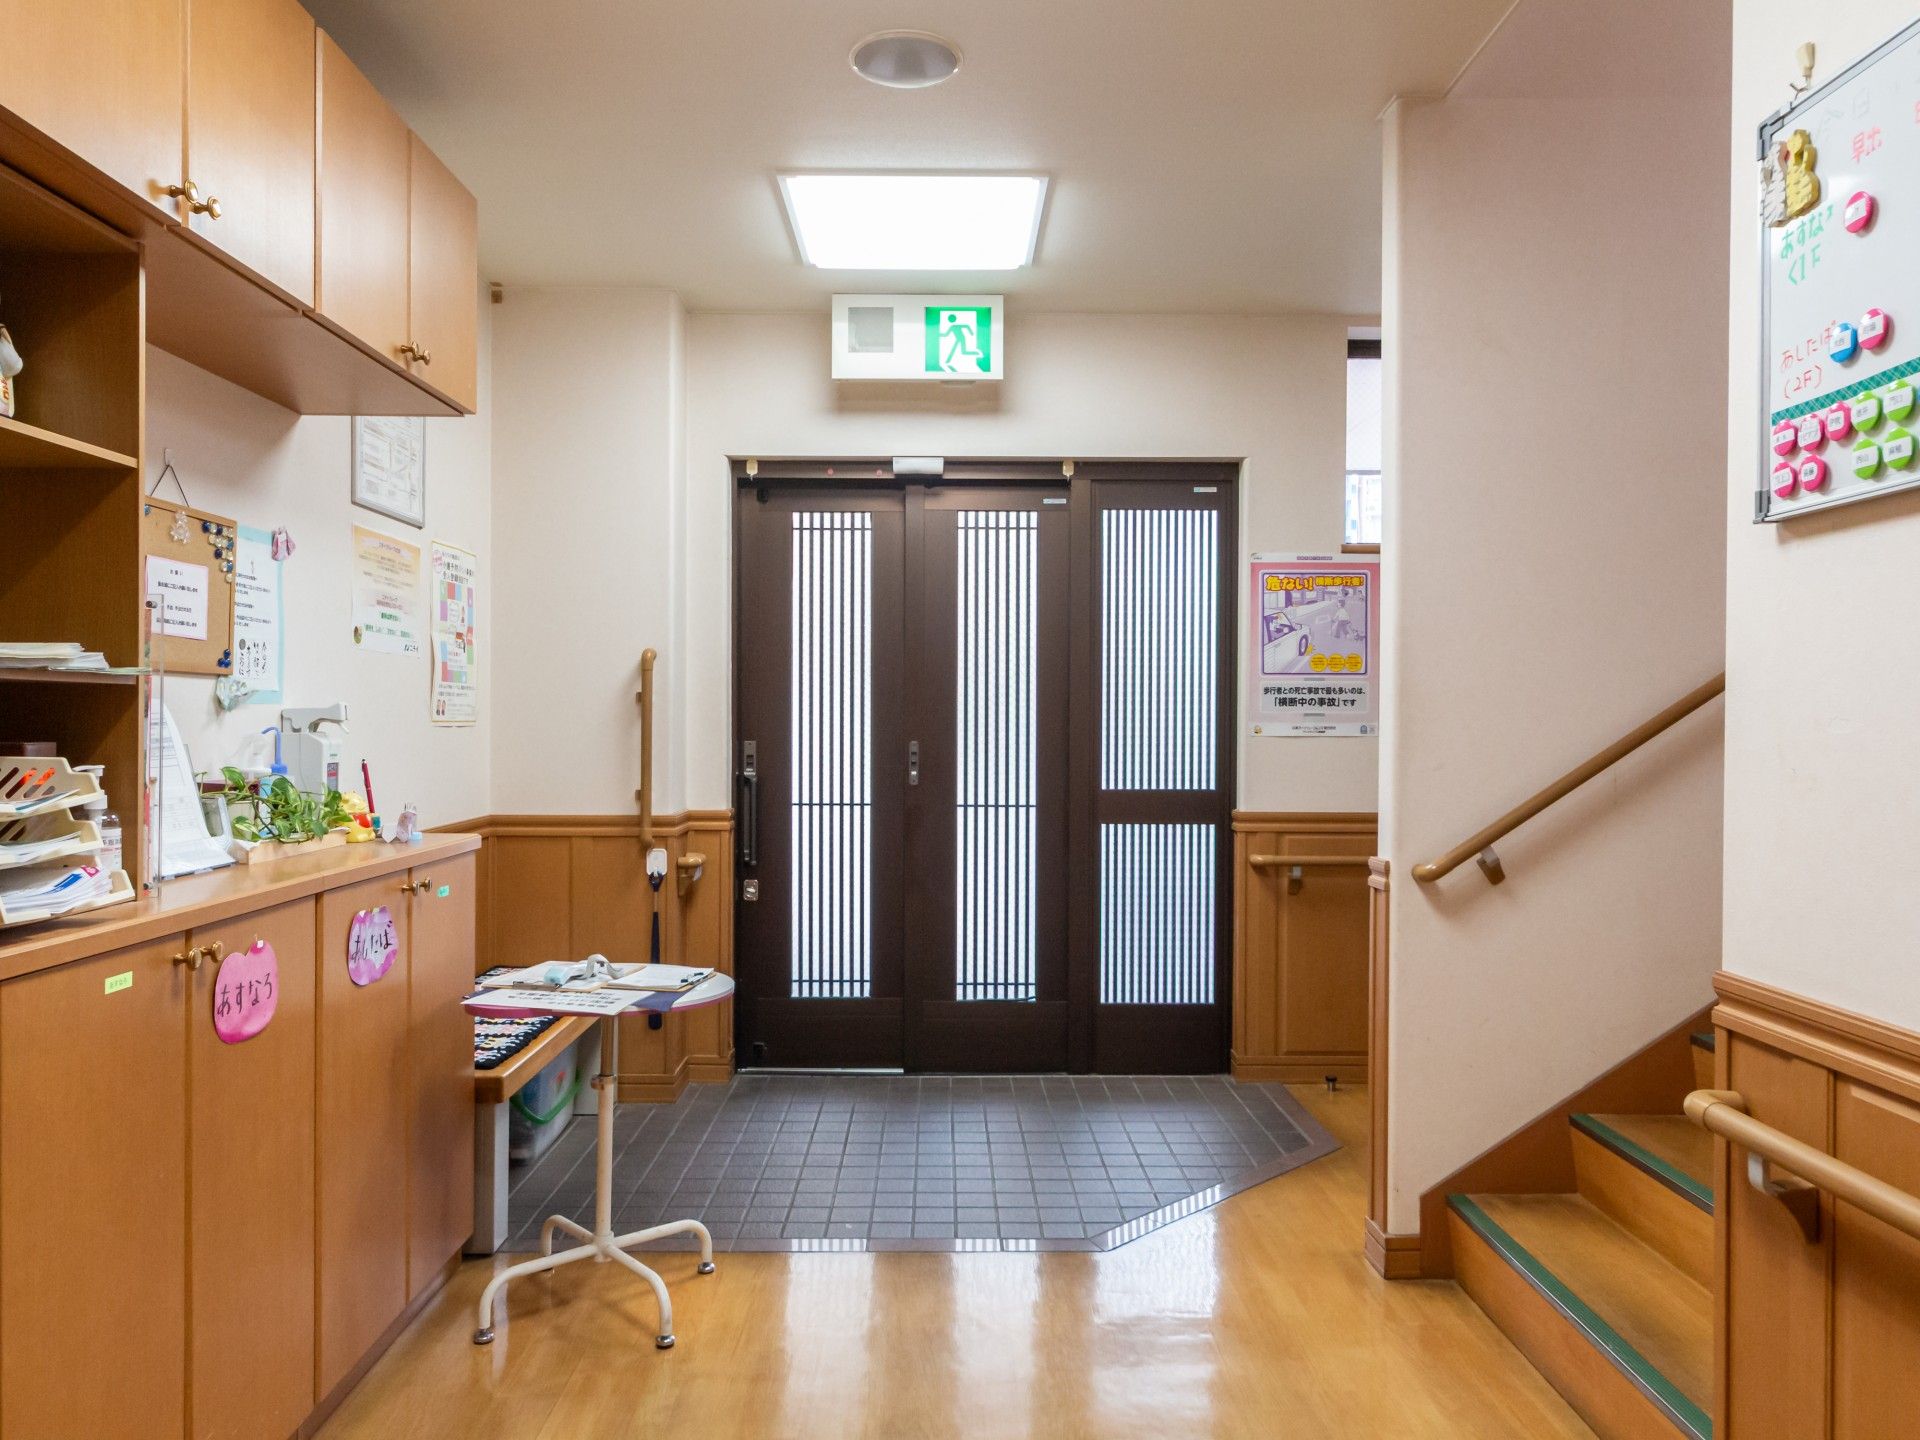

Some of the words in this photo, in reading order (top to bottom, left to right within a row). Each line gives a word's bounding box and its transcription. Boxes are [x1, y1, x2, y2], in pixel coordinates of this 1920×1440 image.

[1273, 697, 1357, 708] 「横断中の事故」です
[216, 972, 273, 1018] あすなろ
